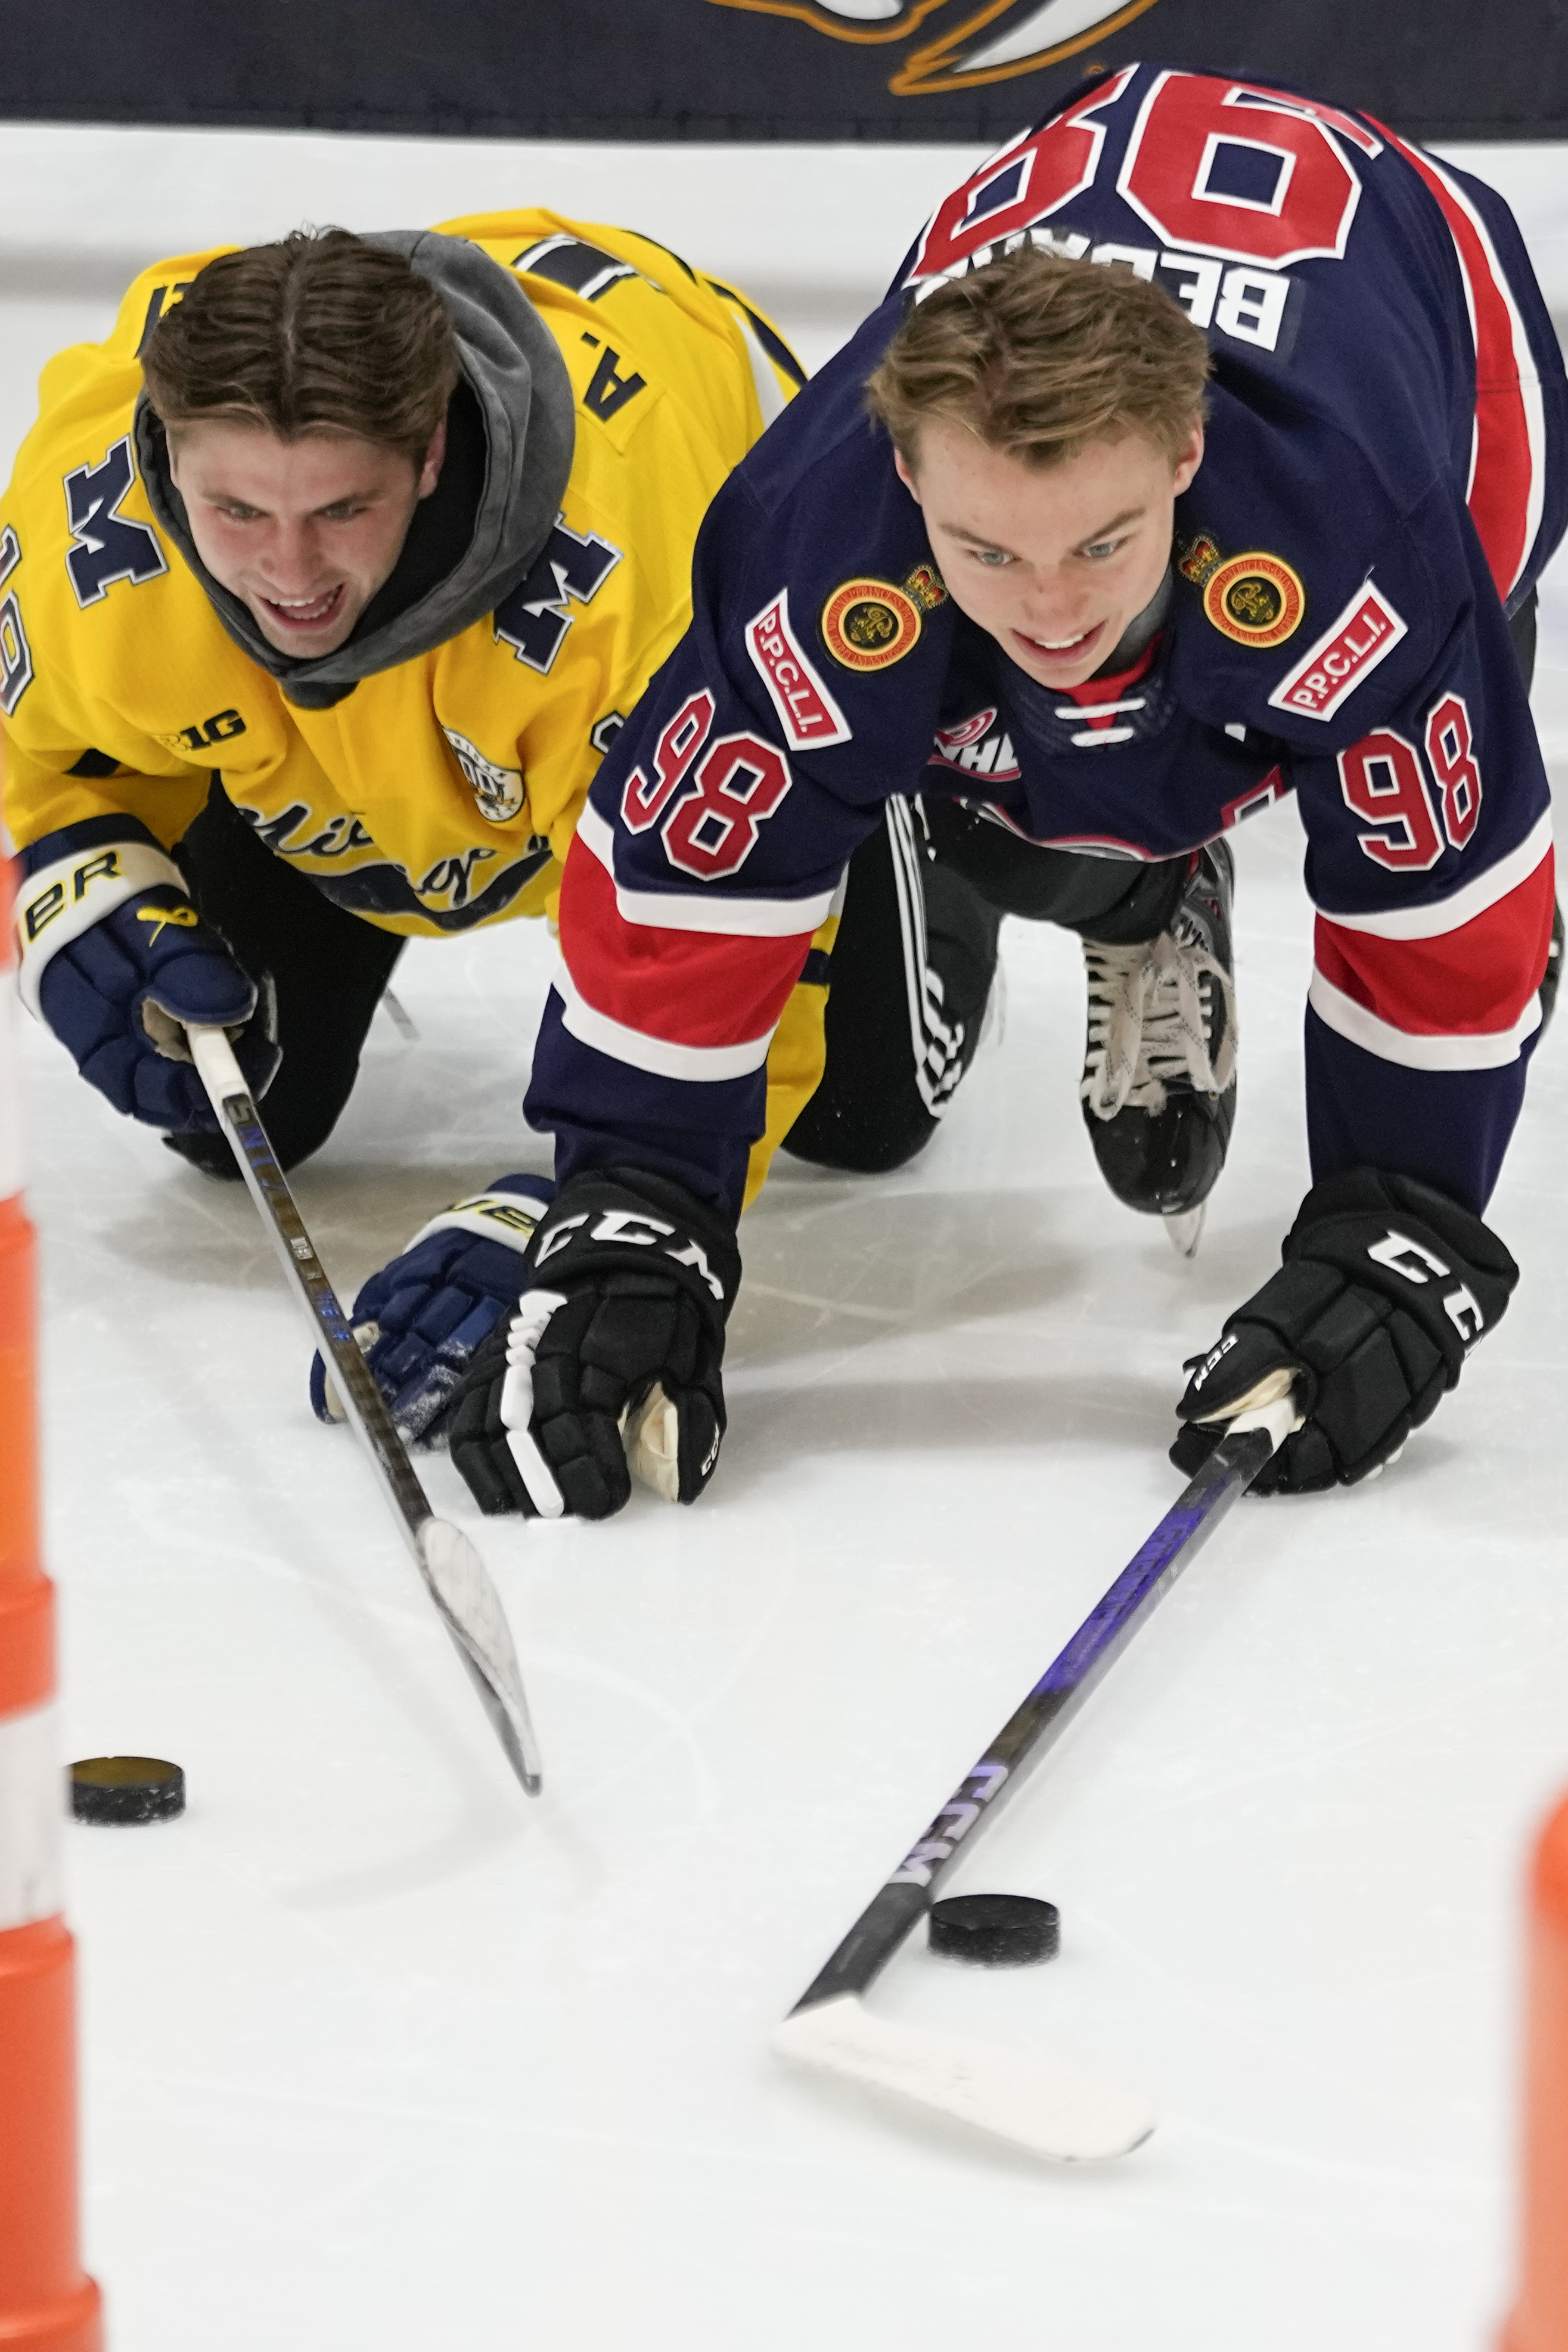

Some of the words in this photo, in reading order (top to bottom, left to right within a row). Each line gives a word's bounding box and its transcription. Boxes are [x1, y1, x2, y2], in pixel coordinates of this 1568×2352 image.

[63, 433, 169, 610] M
[493, 510, 624, 677] M
[758, 610, 823, 733] P.P.C.L.I.
[1291, 613, 1386, 709] P.P.C.L.I.
[621, 688, 793, 881] 98
[1336, 691, 1483, 872] 98
[1367, 1230, 1484, 1354] CC
